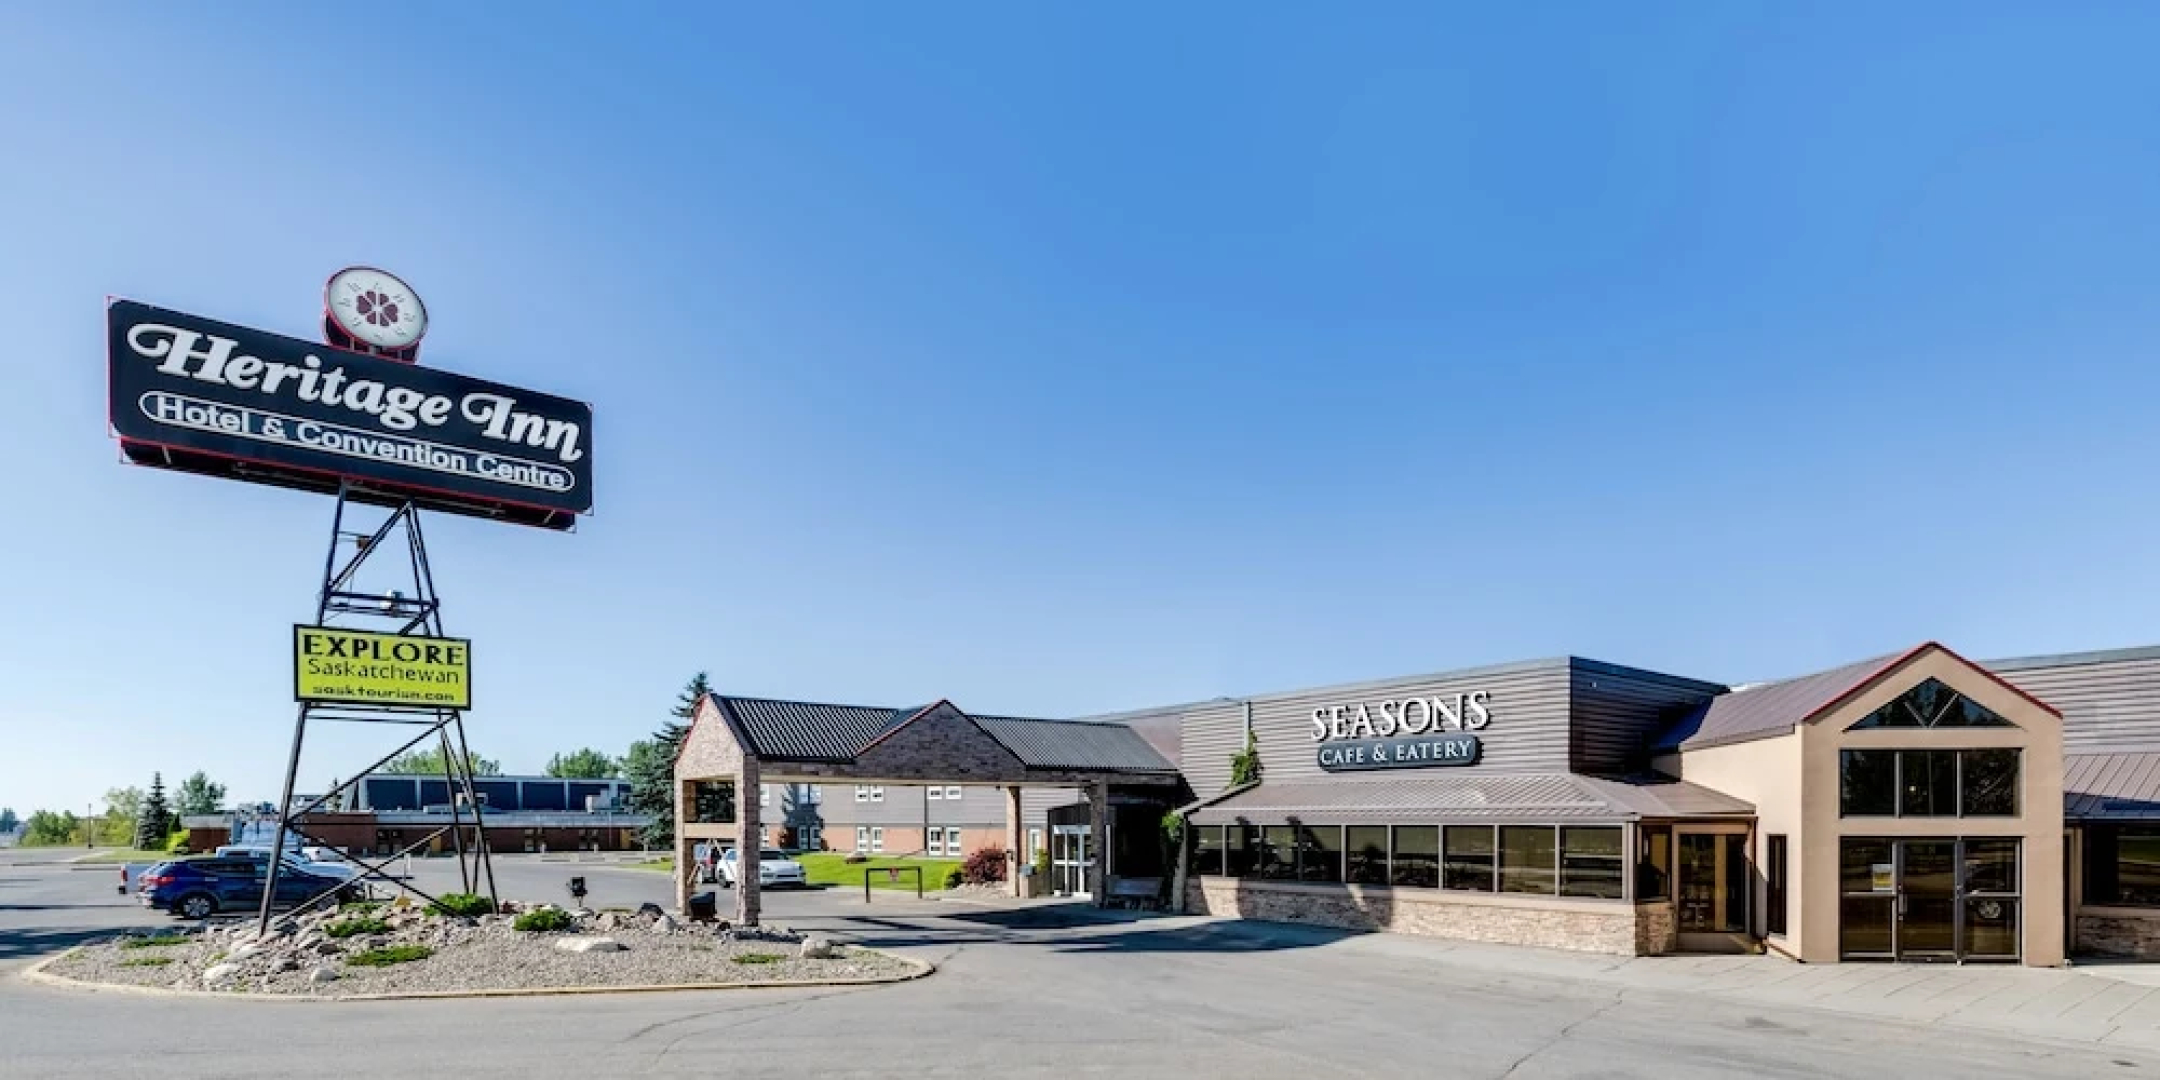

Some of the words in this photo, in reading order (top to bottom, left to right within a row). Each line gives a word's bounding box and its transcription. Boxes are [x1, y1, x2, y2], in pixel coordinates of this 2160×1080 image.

[127, 323, 452, 430] Heritage
[460, 393, 583, 462] Inn
[157, 394, 249, 431] Hotel
[262, 418, 287, 438] &
[296, 424, 466, 471] Convention
[476, 456, 566, 487] Centre
[304, 634, 464, 666] EXPLORE
[308, 658, 459, 684] Saskatchewan
[1311, 690, 1489, 741] SEASONS
[1321, 748, 1364, 765] CAFE
[1373, 743, 1388, 761] &
[1397, 740, 1472, 761] EATERY
